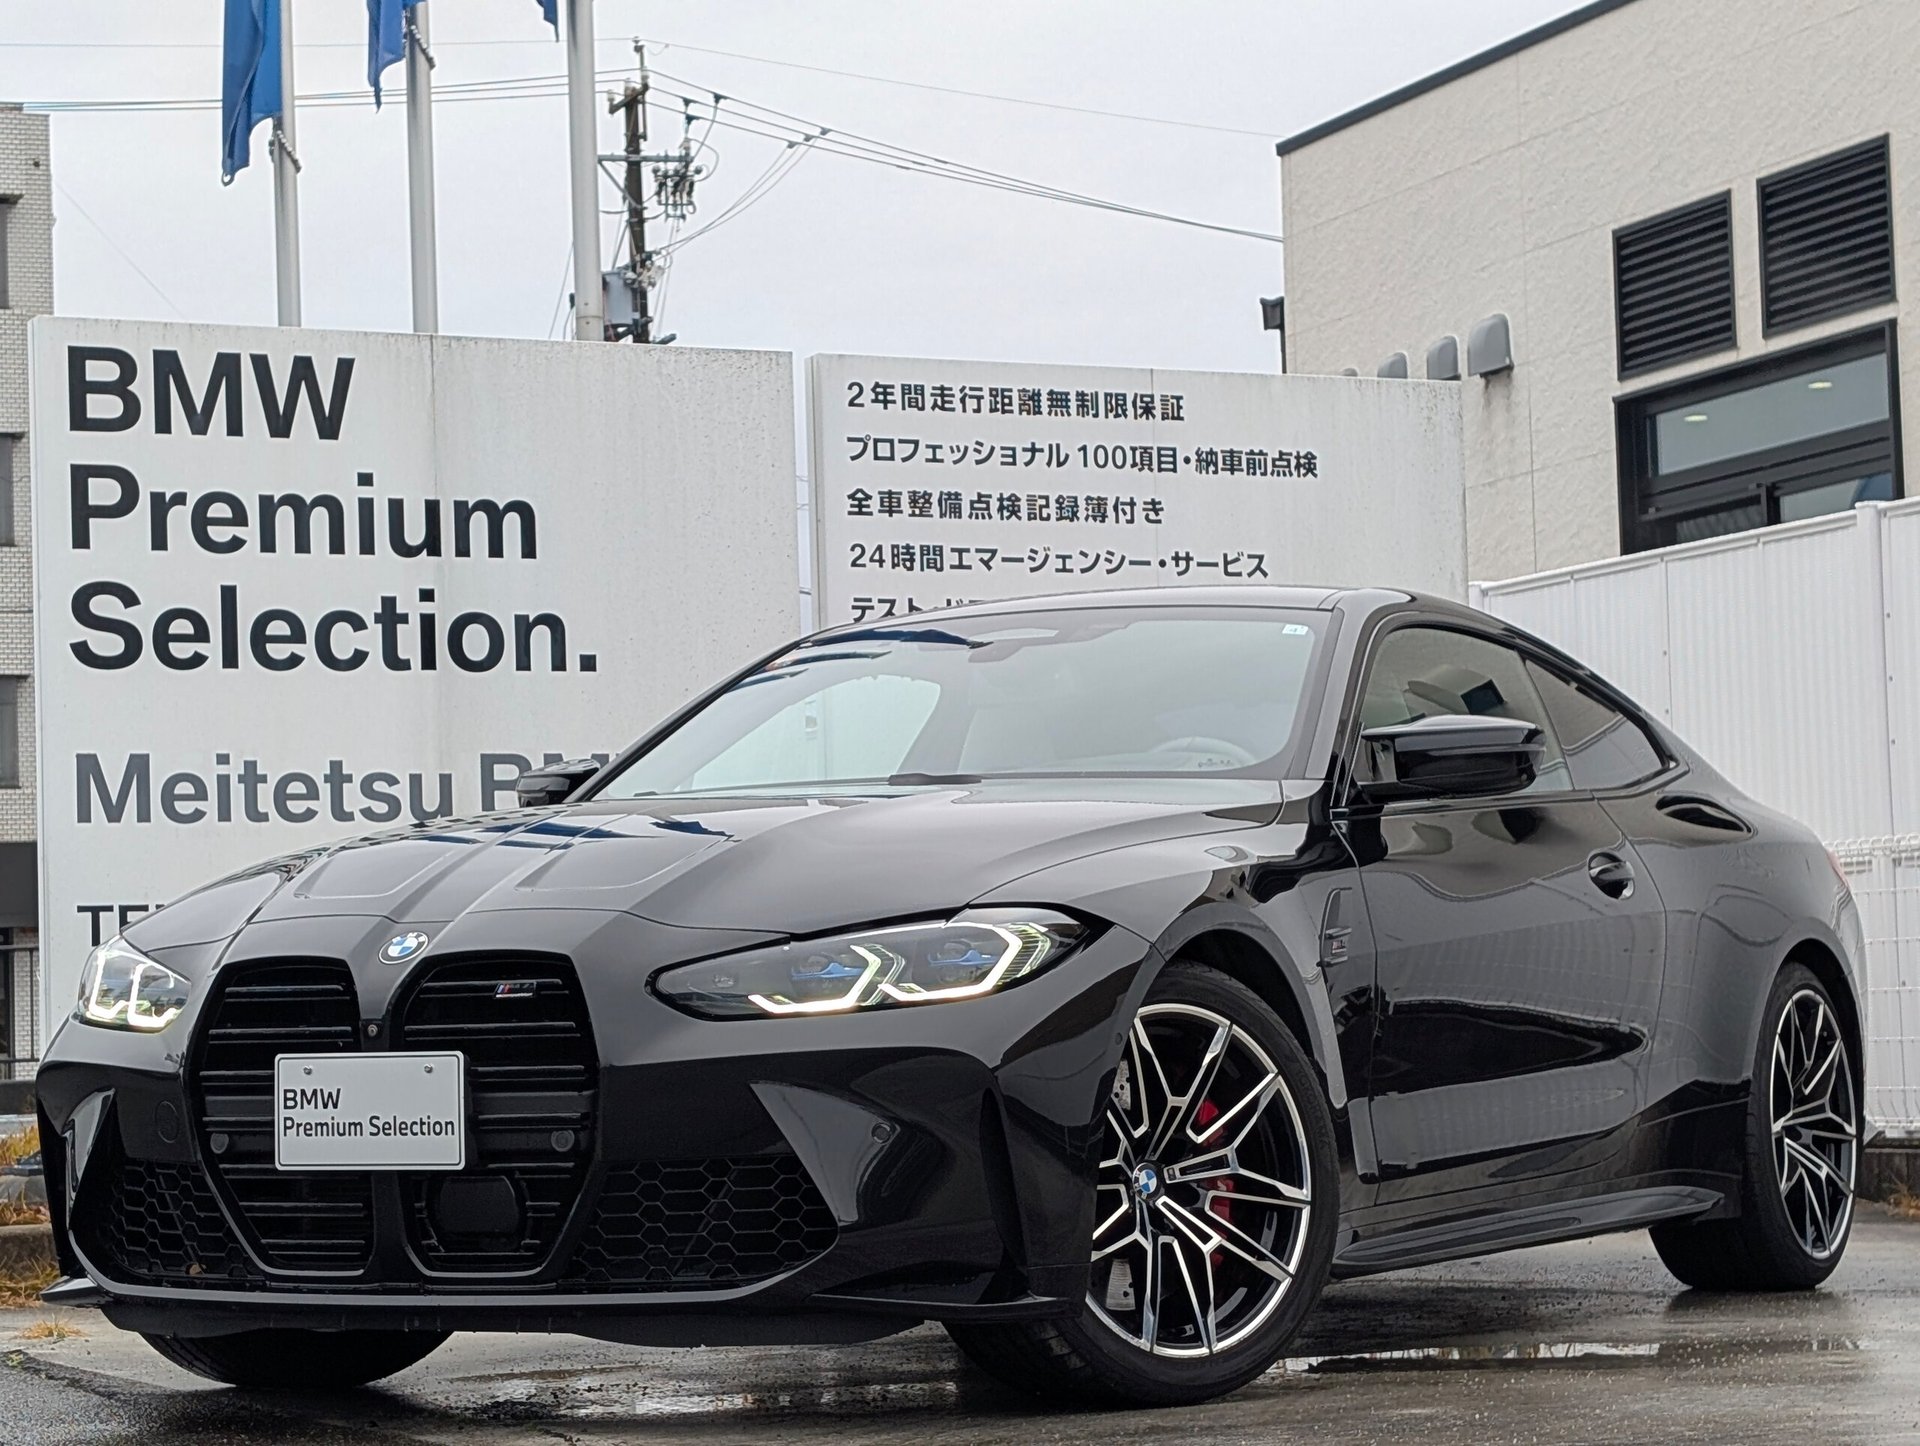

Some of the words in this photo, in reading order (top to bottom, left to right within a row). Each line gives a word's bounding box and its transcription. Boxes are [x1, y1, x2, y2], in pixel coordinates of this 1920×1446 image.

[67, 345, 356, 441] BMW
[847, 381, 1185, 422] 2年間走行距離無制限保証
[69, 463, 537, 560] Premium
[846, 487, 1165, 525] 全車整備点検記録簿付き
[69, 580, 598, 673] Selection.
[75, 752, 453, 825] Meitetsu
[283, 1087, 342, 1110] BMW
[283, 1115, 364, 1138] Premium
[368, 1114, 455, 1137] Selection
